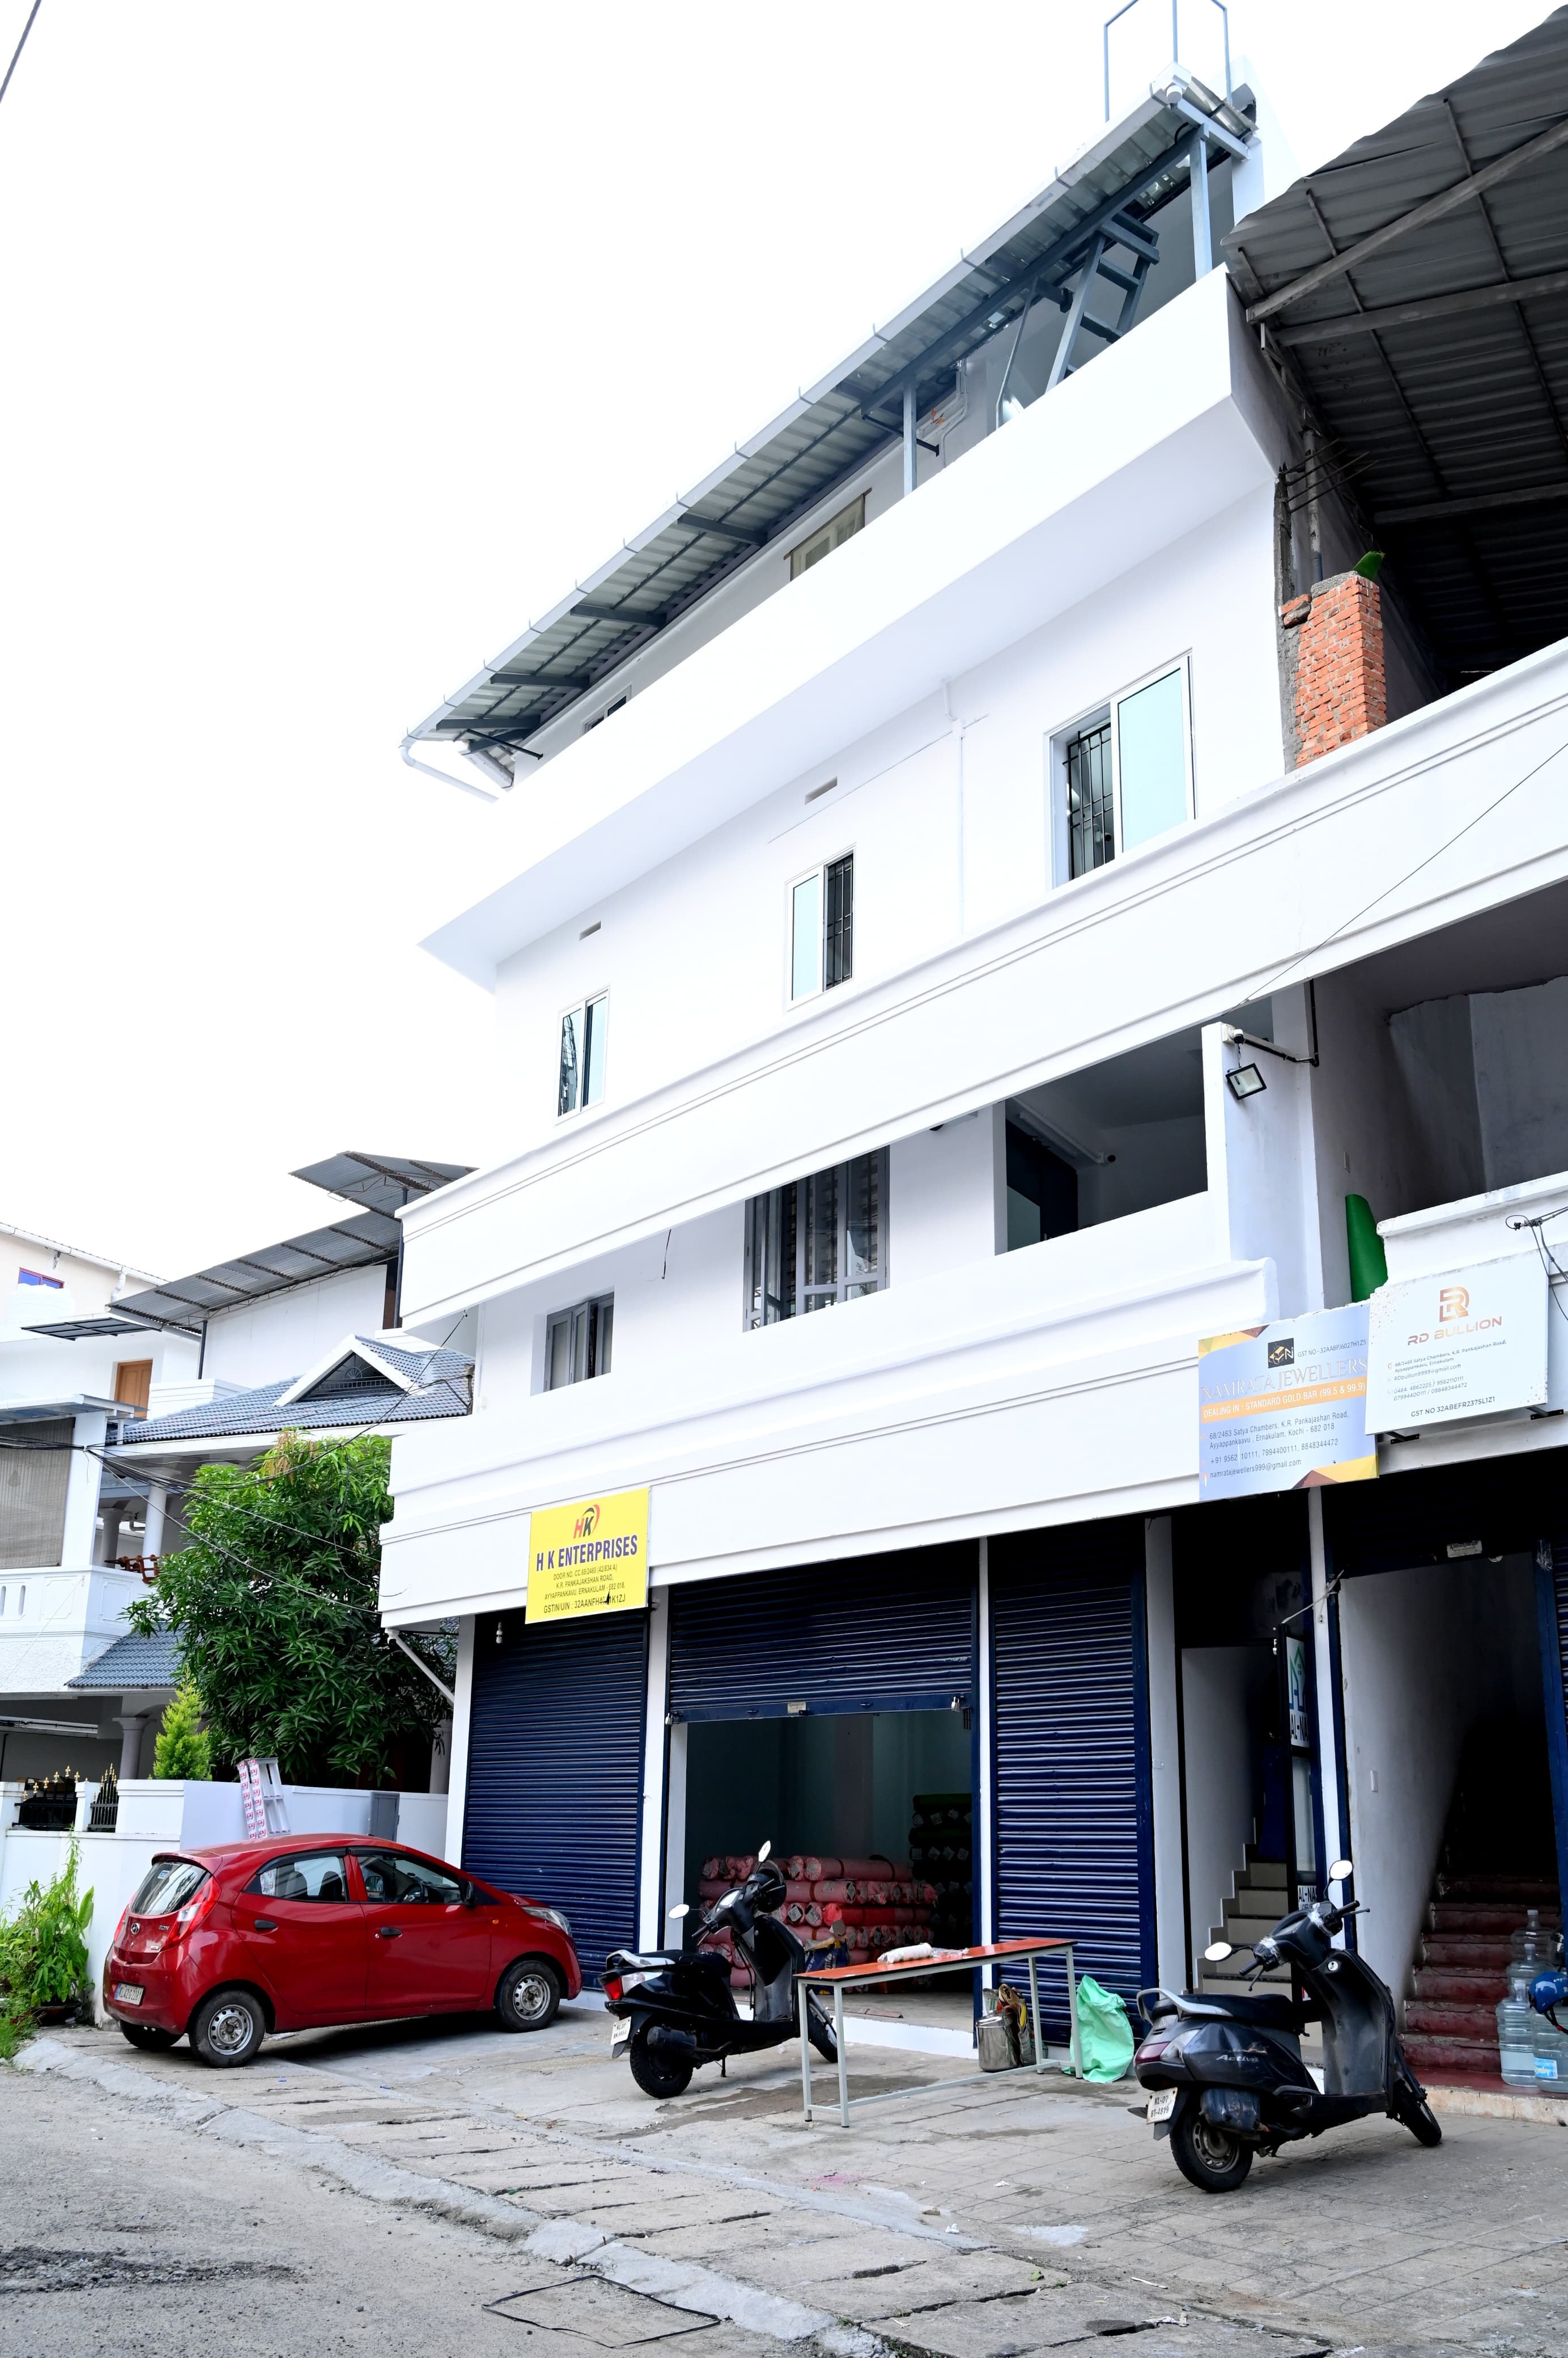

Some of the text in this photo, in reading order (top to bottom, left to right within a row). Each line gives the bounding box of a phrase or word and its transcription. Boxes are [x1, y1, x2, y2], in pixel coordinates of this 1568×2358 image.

[1408, 1316, 1501, 1345] RD BULLION
[1462, 1343, 1491, 1353] Pankajashan
[1429, 1356, 1454, 1365] Ernakulam
[1201, 1356, 1367, 1402] NAMRATA JEWELLERS
[1204, 1405, 1230, 1417] DEALING
[1246, 1396, 1280, 1410] STANDARD
[1283, 1393, 1301, 1403] GOLD
[1303, 1390, 1316, 1399] BAR
[1320, 1386, 1337, 1398] (99.5
[1347, 1381, 1365, 1394] 99.9)
[1209, 1430, 1231, 1439] 68/2463
[1234, 1427, 1248, 1436] Satya
[1250, 1421, 1278, 1433] Chambers,
[1295, 1413, 1329, 1426] Pankajashan
[1332, 1410, 1348, 1420] Road,
[1210, 1436, 1250, 1450] Ayyappankaavu
[1288, 1427, 1303, 1436] Kochi
[1301, 1438, 1337, 1451] 8848344472
[1210, 1458, 1301, 1479] namratajewellers999@gmail.com
[573, 1516, 594, 1538] HK
[537, 1534, 637, 1571] H K ENTERPRISES
[613, 1563, 617, 1572] A)
[565, 1576, 598, 1587] PANKAJAKSHAN
[600, 1574, 613, 1582] ROAD,
[579, 1584, 605, 1594] ERNAKULAM
[544, 1601, 570, 1613] GSTIN/UIN
[1154, 2095, 1169, 2105] KL-07
